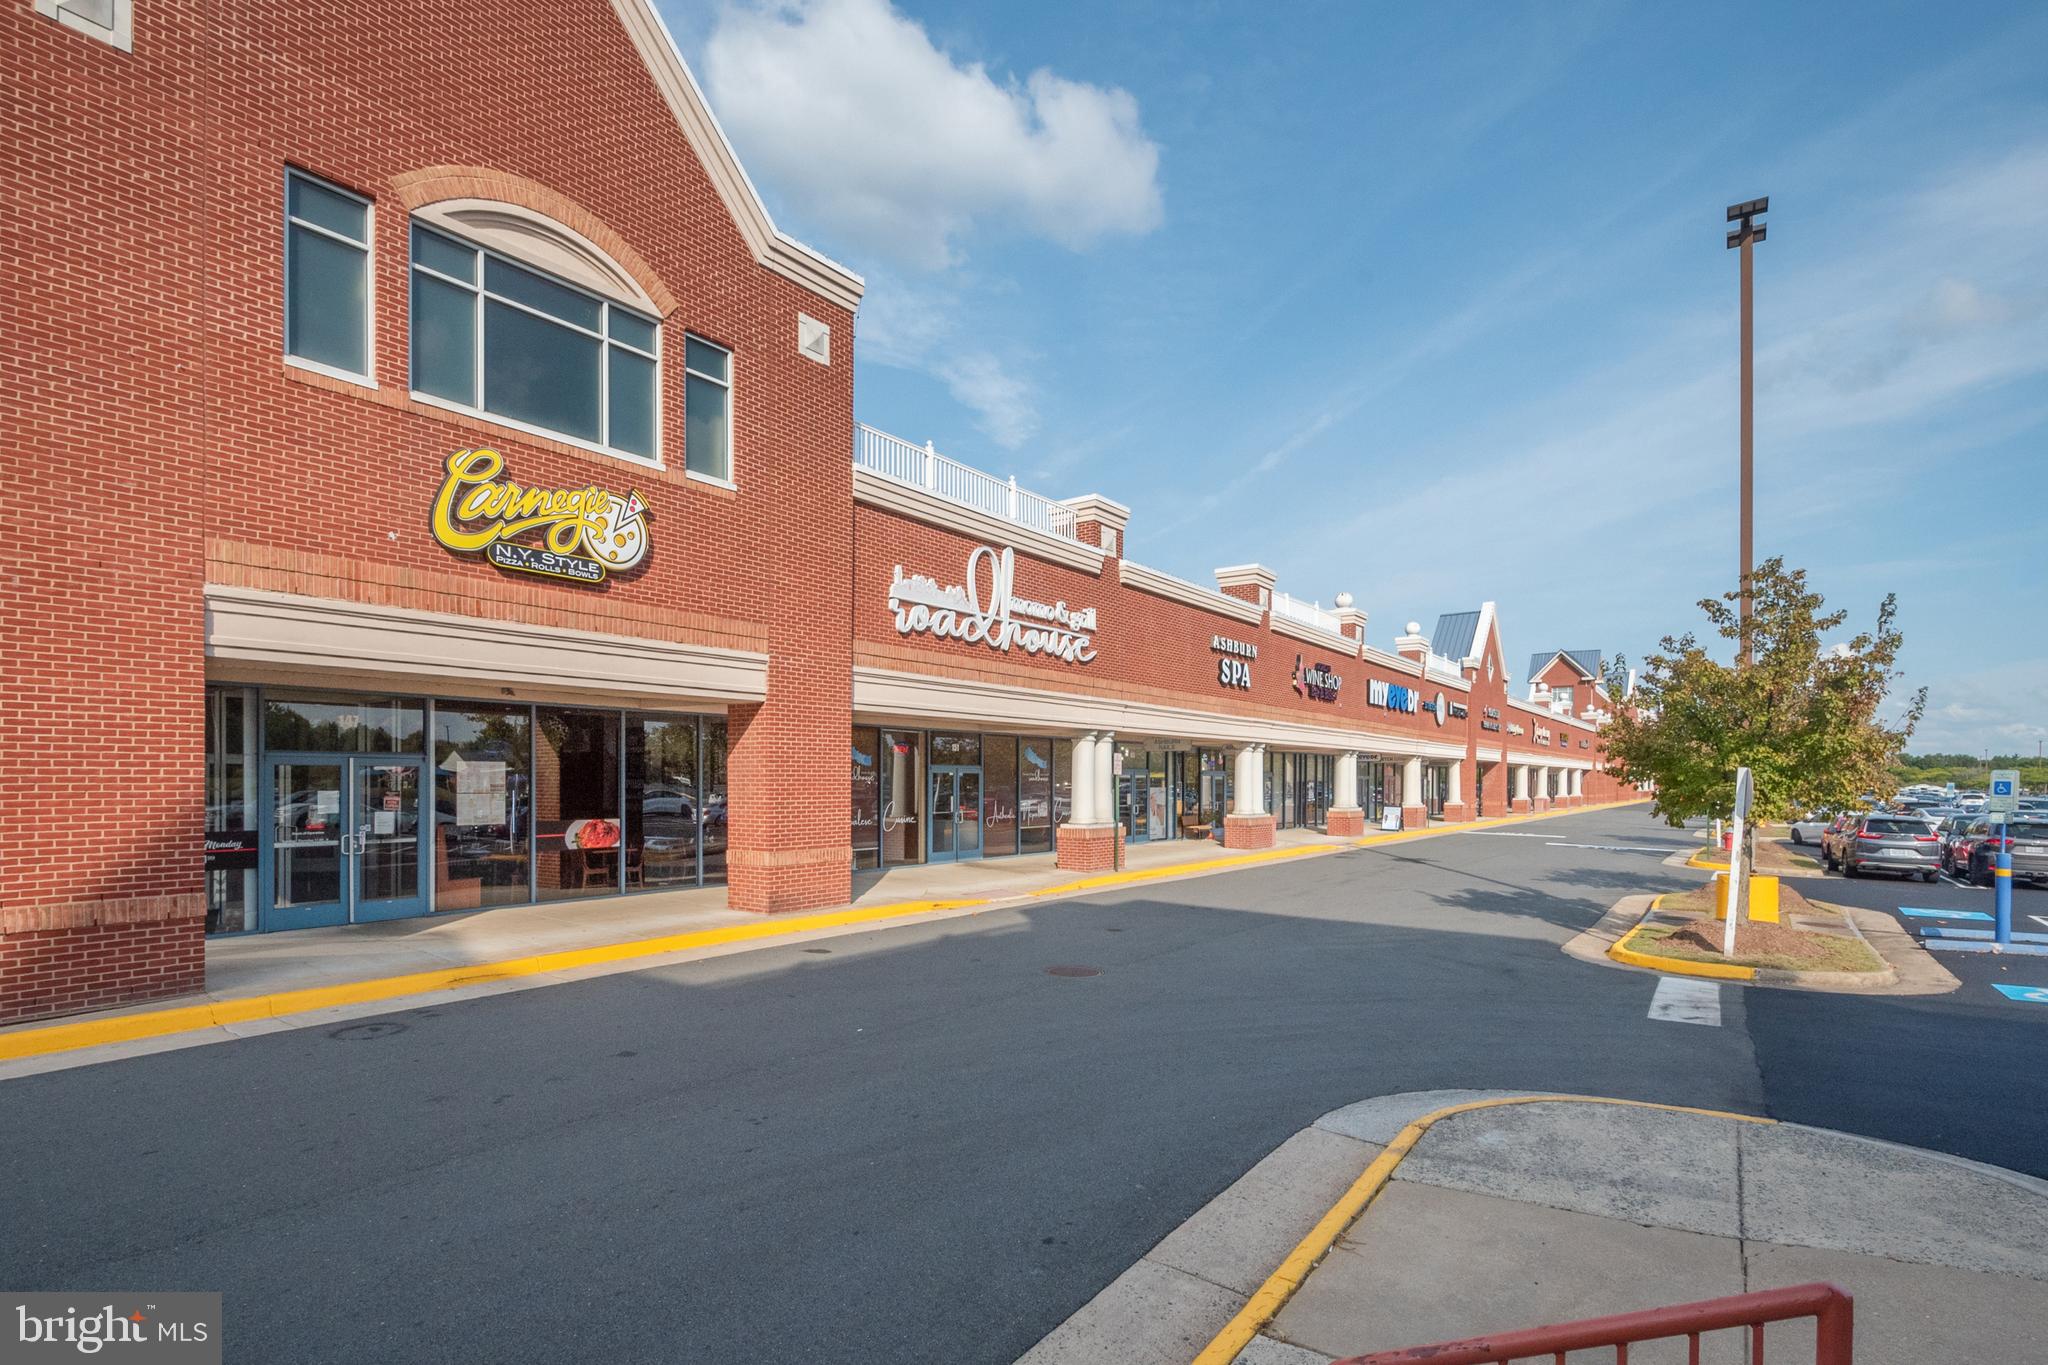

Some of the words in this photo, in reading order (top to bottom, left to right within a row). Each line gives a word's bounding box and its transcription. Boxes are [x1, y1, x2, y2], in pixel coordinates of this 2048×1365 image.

[433, 448, 610, 554] Carnegie
[496, 543, 535, 563] N.Y.
[541, 553, 599, 573] STYLE
[531, 562, 561, 573] ROLLS
[568, 568, 598, 580] BOWLS
[1213, 635, 1258, 659] ASHBURN
[1221, 657, 1251, 688] SPA
[1305, 667, 1325, 688] WINE
[1324, 672, 1343, 692] SHOP
